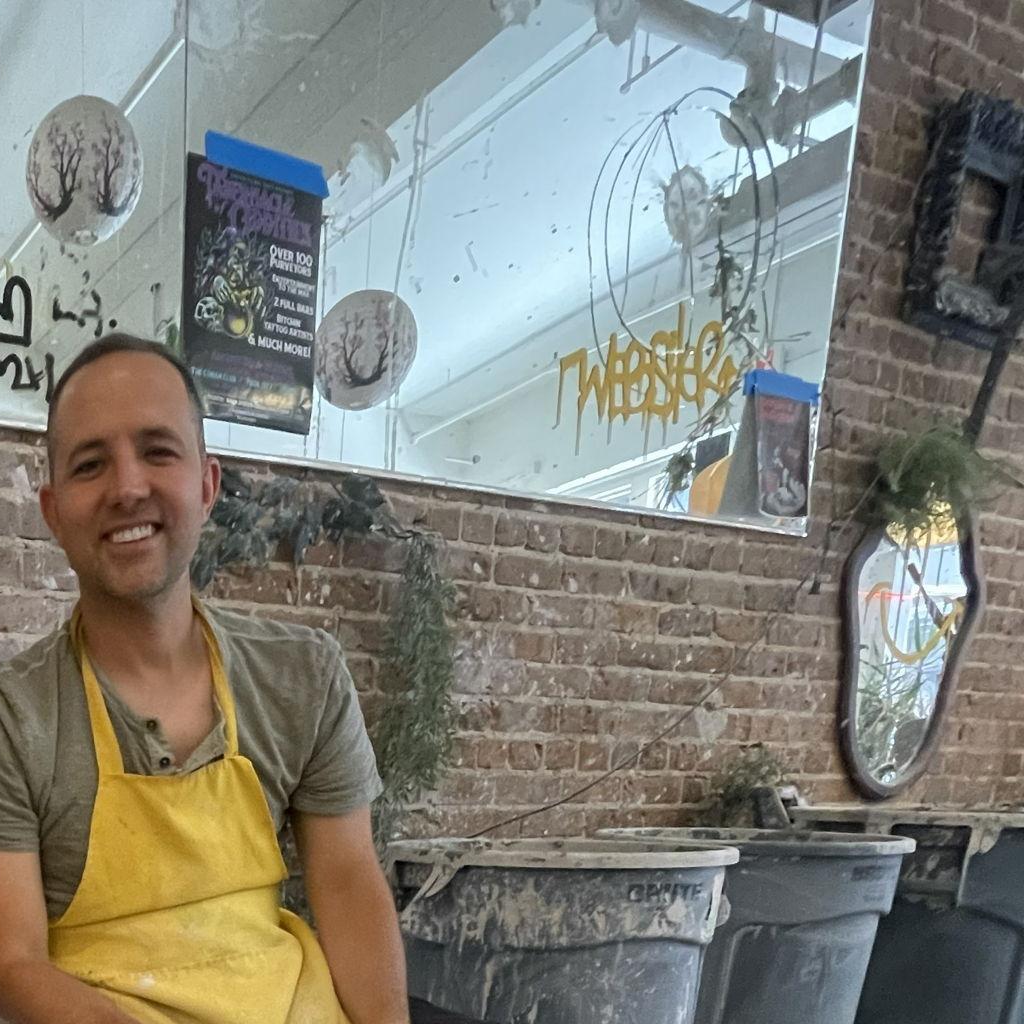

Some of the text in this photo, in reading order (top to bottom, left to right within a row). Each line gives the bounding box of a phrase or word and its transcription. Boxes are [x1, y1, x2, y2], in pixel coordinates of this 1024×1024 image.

[269, 244, 313, 267] OVER 100
[269, 257, 312, 278] PURVEYORS
[273, 296, 314, 316] 2 FULL BARS
[247, 332, 256, 346] &
[257, 335, 283, 352] MUCH
